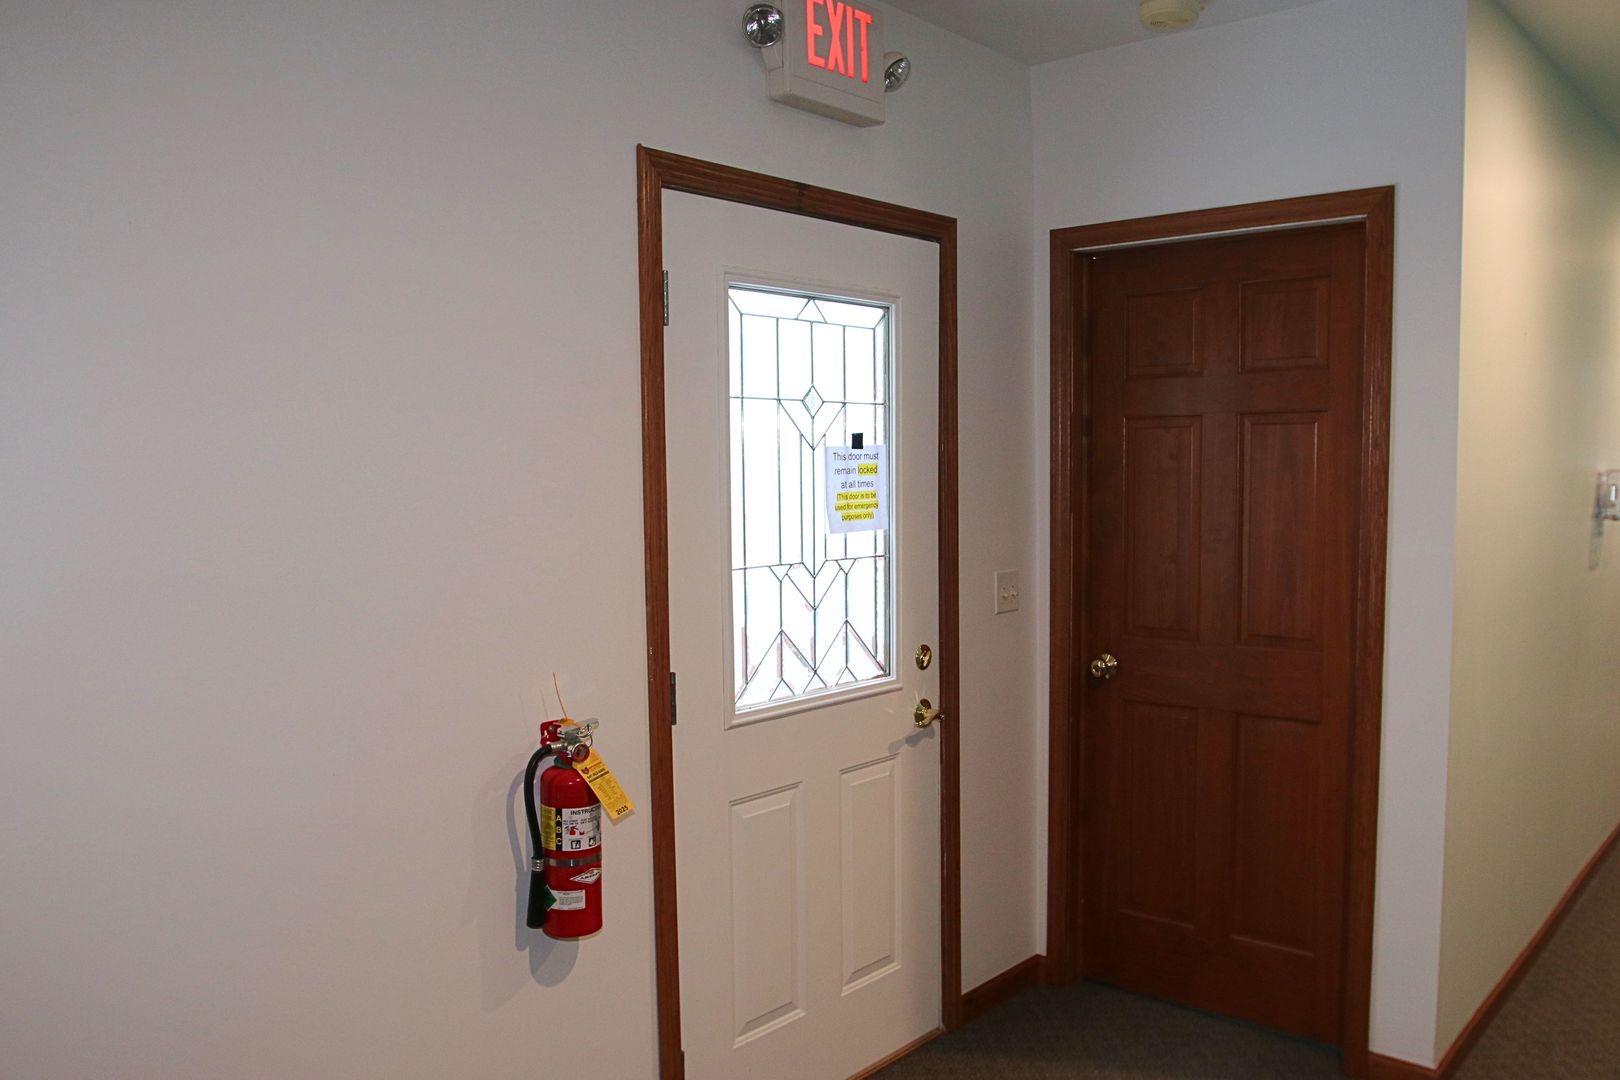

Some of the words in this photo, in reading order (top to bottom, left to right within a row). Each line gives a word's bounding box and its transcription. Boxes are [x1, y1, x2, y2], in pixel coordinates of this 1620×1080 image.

[806, 0, 873, 84] EXIT
[833, 452, 847, 461] This
[848, 452, 862, 461] door
[864, 452, 879, 460] must
[835, 467, 857, 475] remain
[858, 465, 878, 474] locked
[841, 481, 848, 489] at
[849, 480, 857, 488] all
[858, 480, 874, 488] times
[849, 492, 860, 500] door
[835, 503, 846, 511] used
[854, 501, 879, 510] emergency
[842, 513, 863, 522] purposes
[615, 804, 629, 816] 2025
[556, 826, 562, 834] B
[556, 837, 562, 845] C
